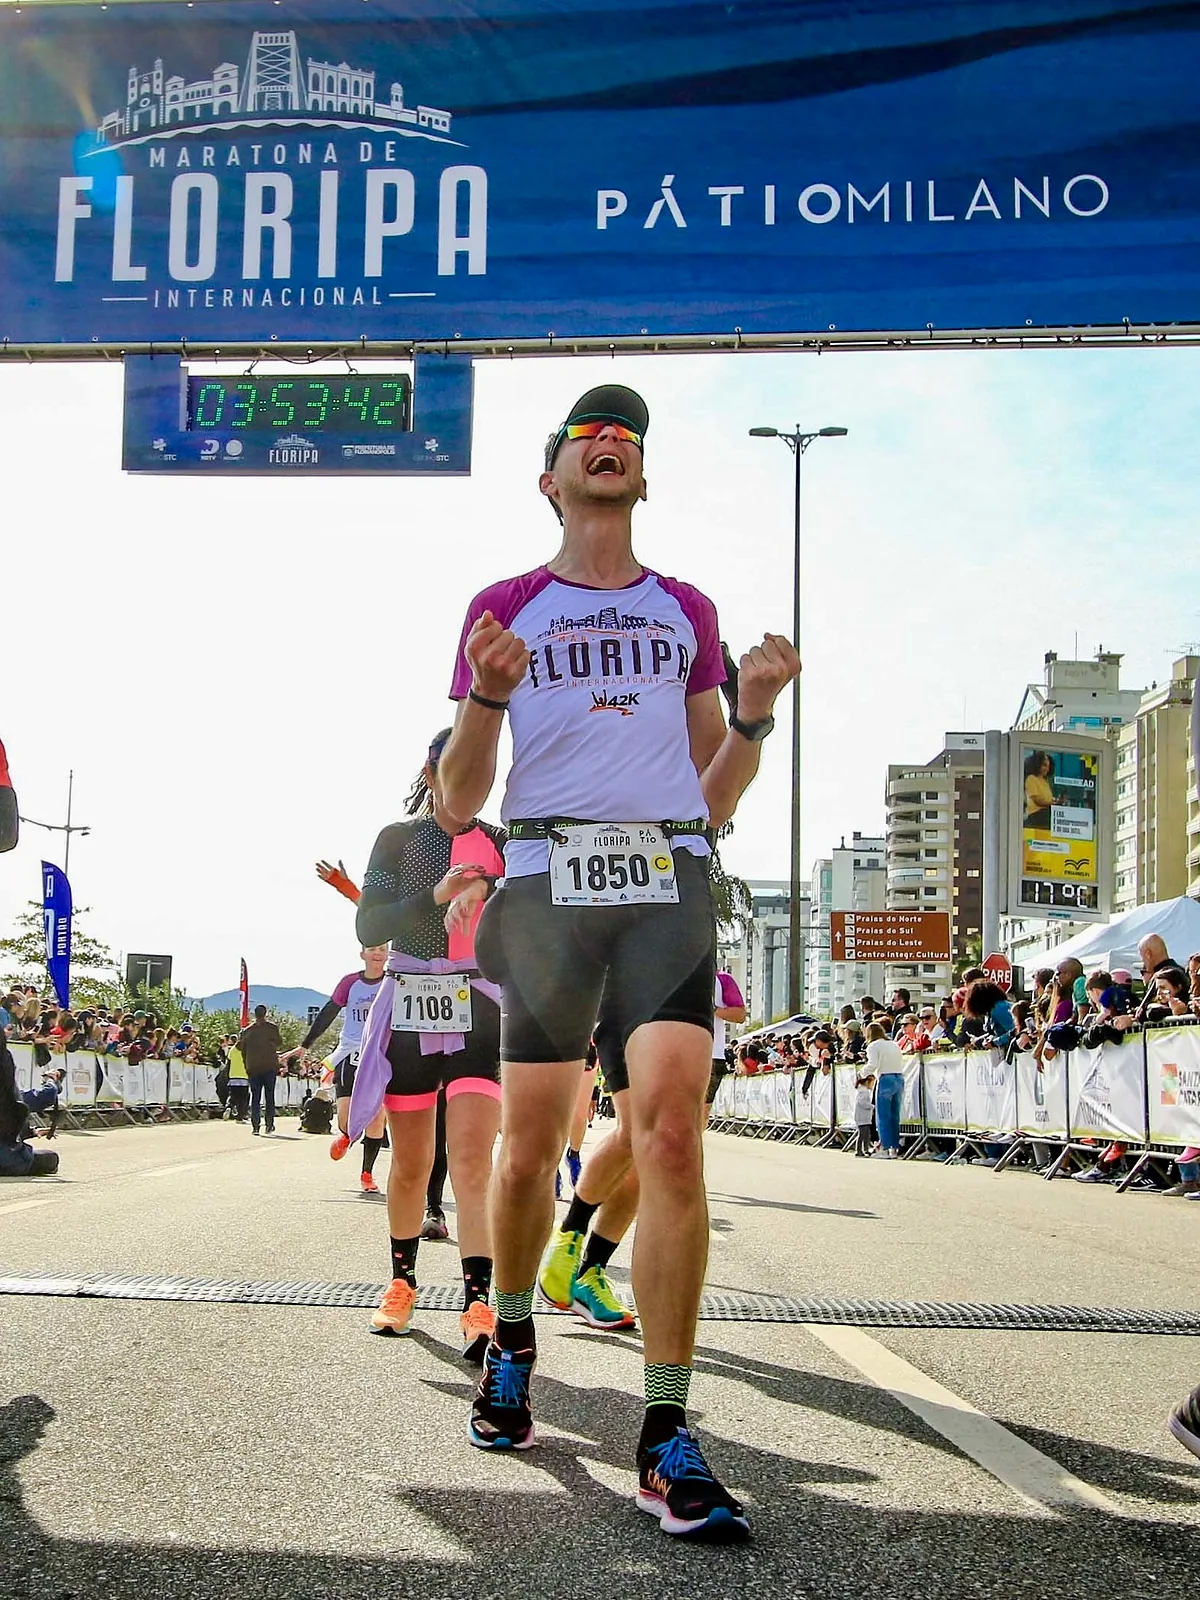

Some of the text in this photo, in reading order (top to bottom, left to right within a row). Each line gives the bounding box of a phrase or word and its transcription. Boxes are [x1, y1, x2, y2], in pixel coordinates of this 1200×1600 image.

[150, 141, 396, 168] MARATONA DE
[55, 165, 488, 282] FLORIPA
[154, 286, 381, 308] INTERNACIONAL
[196, 384, 401, 427] 03:53:42
[269, 449, 318, 463] FLORIPA
[529, 638, 689, 688] FLORIPA
[566, 677, 660, 687] INTERNACIONAL
[607, 692, 641, 708] 42K
[594, 835, 631, 847] FLORIPA
[640, 836, 657, 844] TIO
[655, 857, 668, 870] C
[567, 853, 650, 891] 1850
[856, 915, 883, 923] Praias
[899, 915, 922, 923] Norte
[983, 968, 1011, 985] PARE
[458, 990, 467, 1000] C
[403, 995, 453, 1021] 1108
